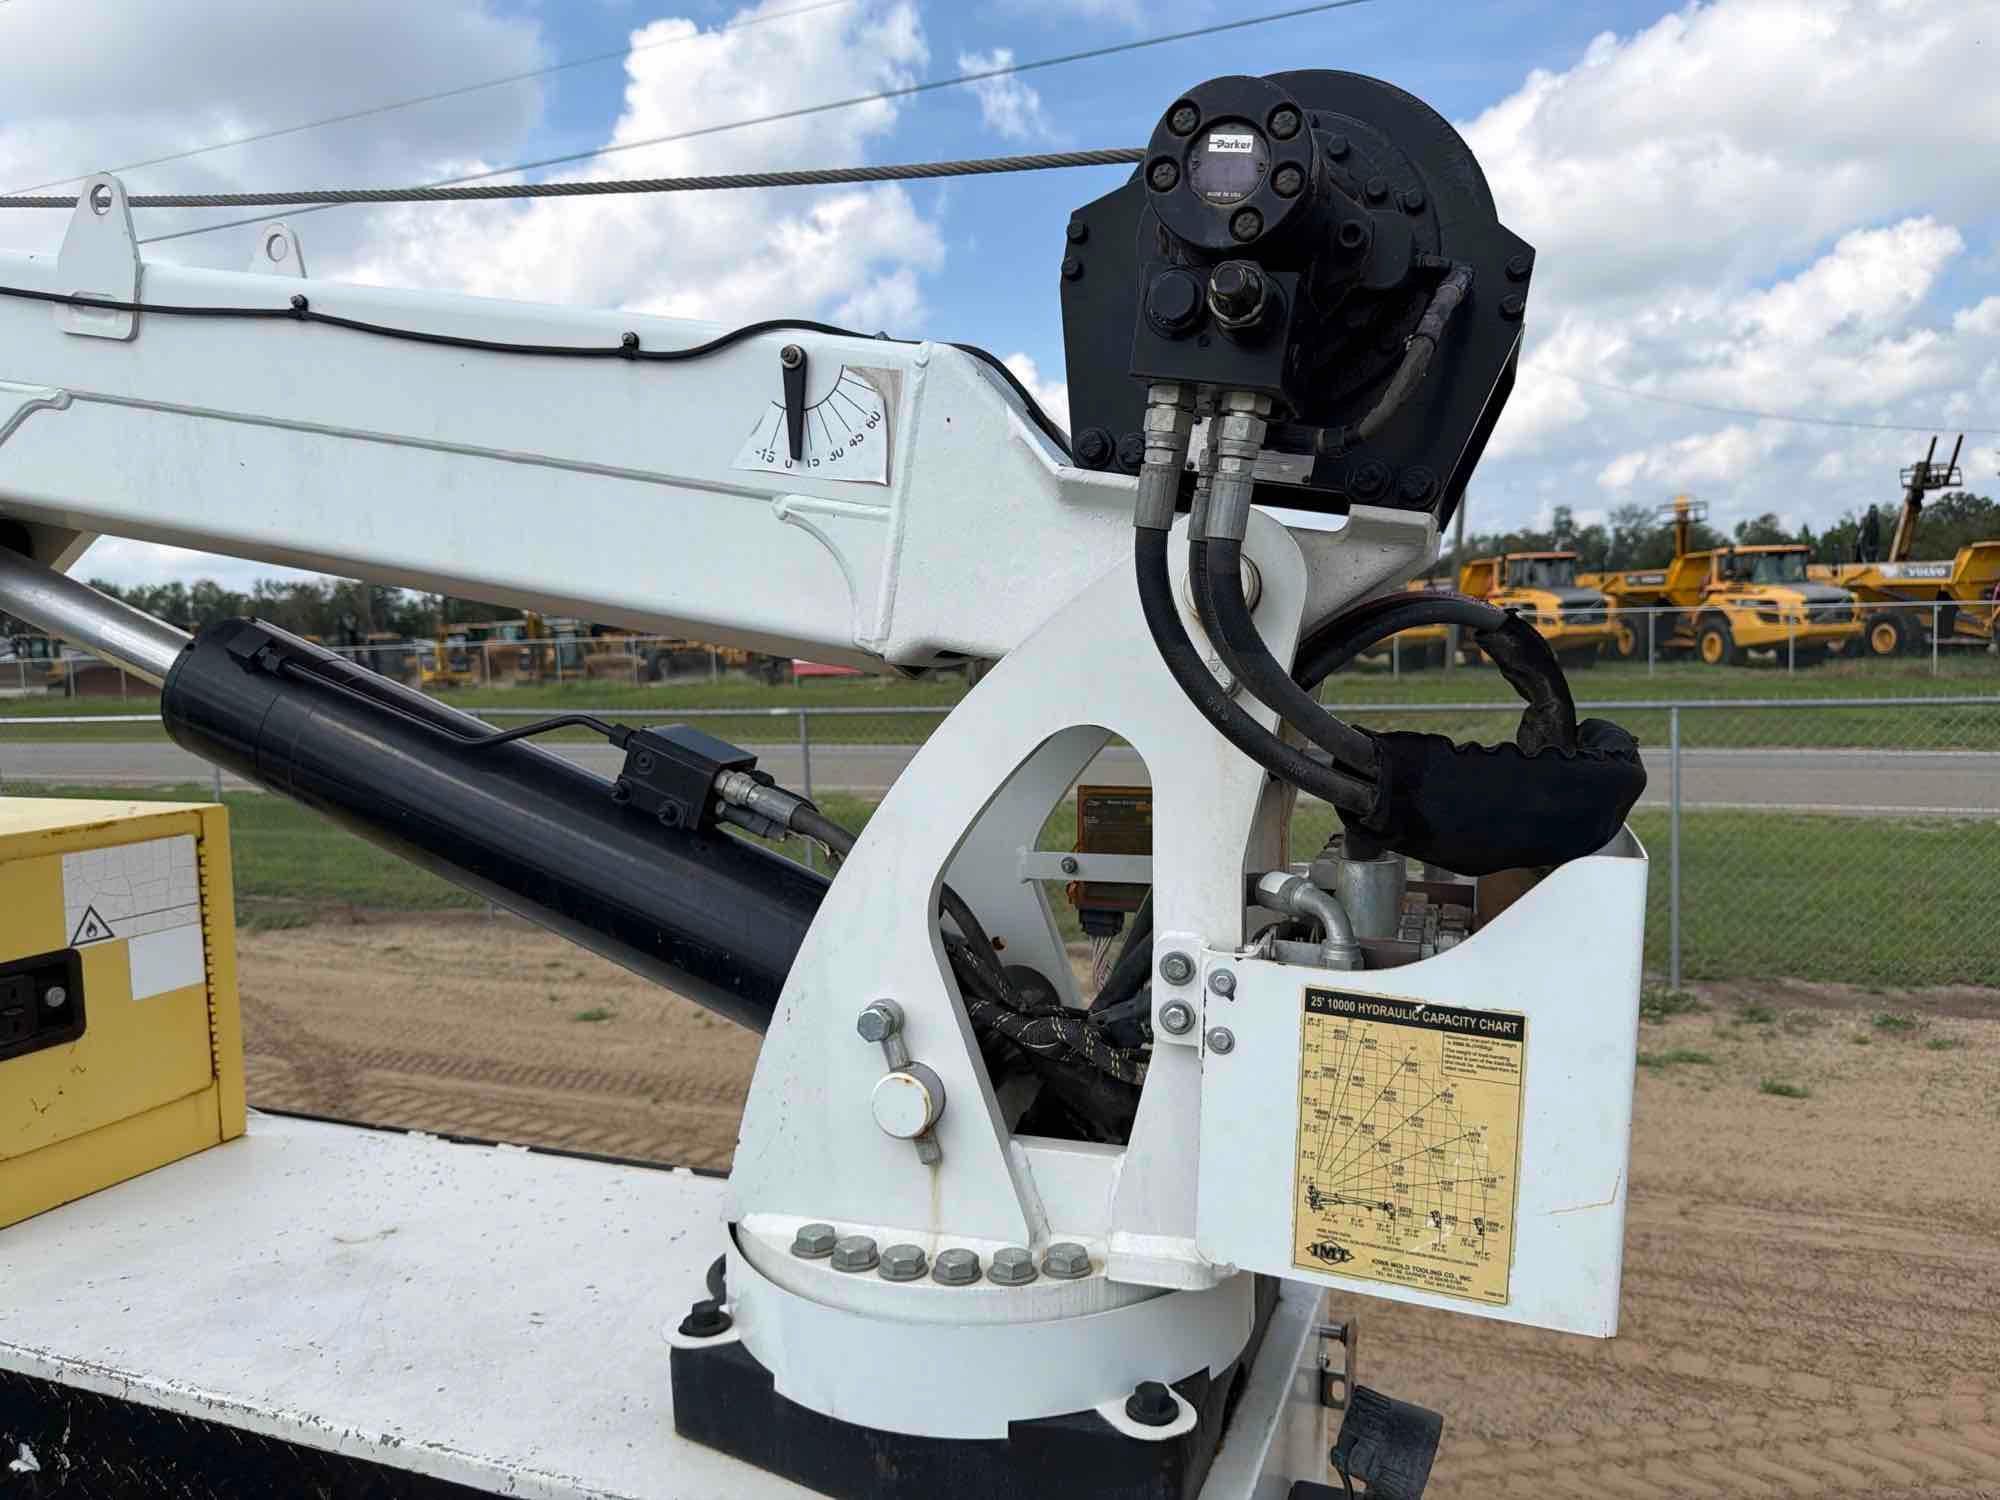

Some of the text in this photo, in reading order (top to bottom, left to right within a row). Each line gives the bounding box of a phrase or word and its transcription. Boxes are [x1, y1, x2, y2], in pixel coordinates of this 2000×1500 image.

[1212, 139, 1251, 150] Parker
[849, 433, 864, 448] 45
[1907, 567, 1946, 577] VOLVO
[1328, 999, 1356, 1012] 10000
[1358, 1002, 1420, 1021] HYDRAULIC
[1422, 1011, 1477, 1029] CAPACITY
[1479, 1018, 1519, 1034] CHART
